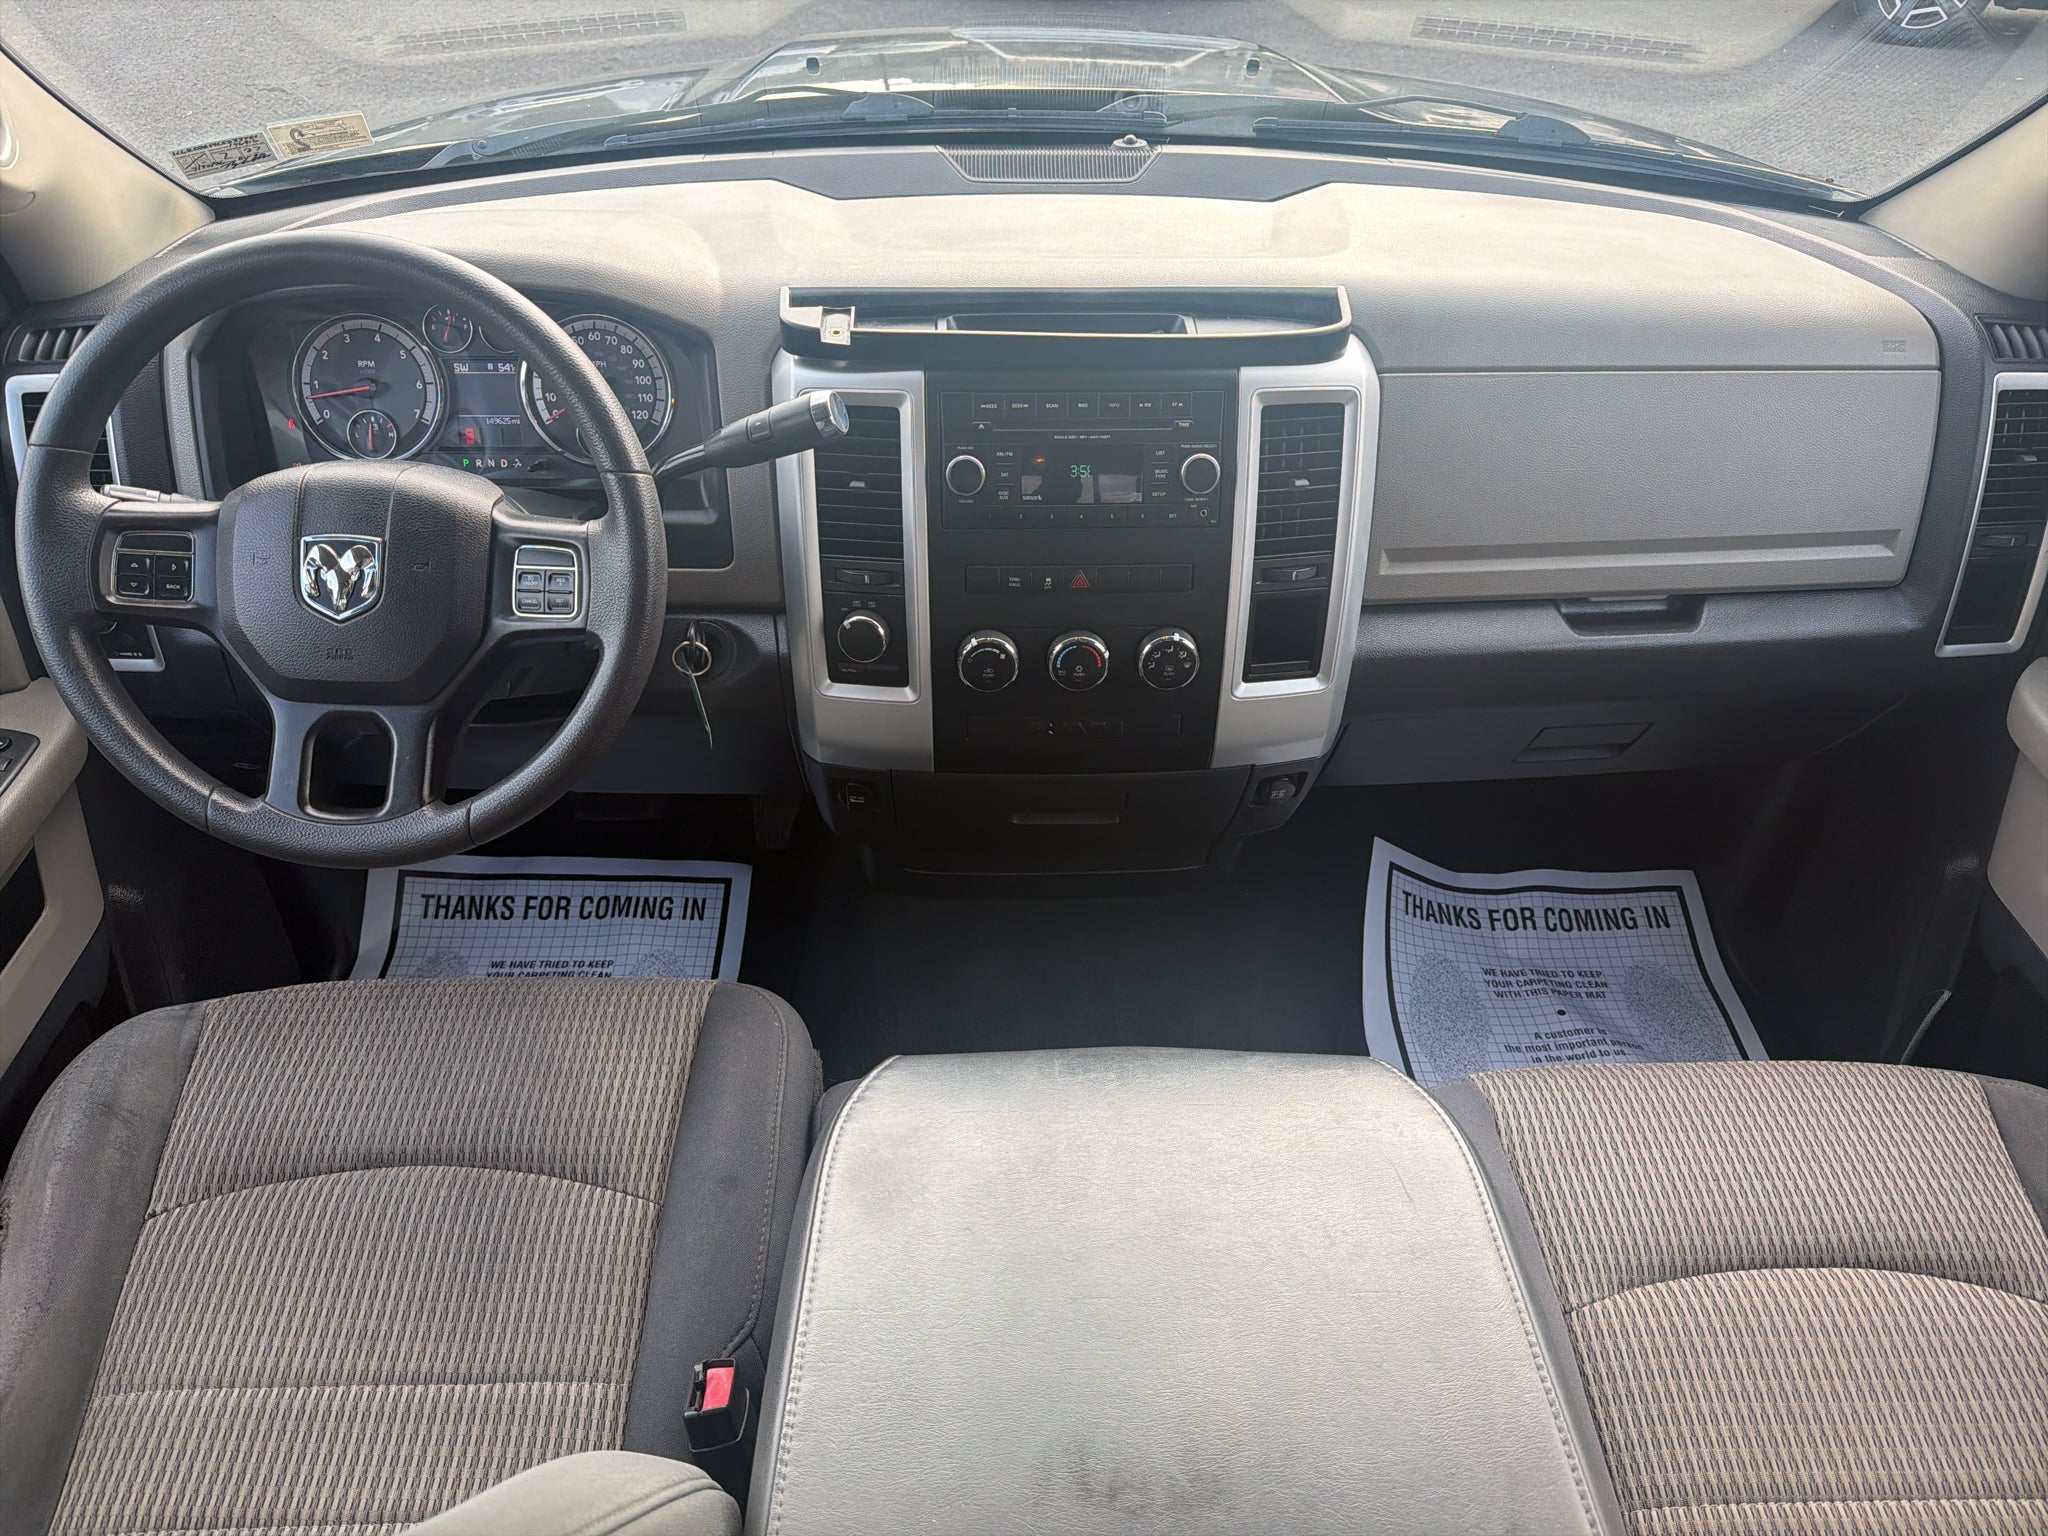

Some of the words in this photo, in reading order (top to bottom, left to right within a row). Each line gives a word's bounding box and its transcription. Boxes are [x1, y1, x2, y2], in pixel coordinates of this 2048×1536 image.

[343, 334, 351, 343] 3
[374, 334, 381, 343] 4
[588, 331, 601, 341] 60
[605, 336, 618, 346] 70
[620, 345, 633, 354] 80
[321, 350, 329, 360] 2
[400, 350, 407, 360] 5
[357, 360, 376, 368] RPM
[453, 363, 469, 372] SW
[632, 359, 645, 368] 90
[313, 380, 319, 389] 1
[635, 376, 652, 385] 100
[416, 382, 423, 390] 6
[545, 393, 557, 402] 10
[637, 393, 654, 402] 110
[323, 409, 331, 419] 0
[413, 409, 421, 419] 7
[631, 410, 649, 420] 120
[463, 459, 470, 468] P
[476, 459, 482, 468] R
[488, 459, 495, 468] N
[500, 459, 508, 468] D
[420, 893, 515, 921] THANKS
[522, 895, 572, 921] FOR
[578, 895, 675, 921] COMING
[681, 897, 707, 921] IN
[1402, 890, 1482, 931] THANKS
[1488, 906, 1538, 932] FOR
[1543, 906, 1639, 932] COMING
[1643, 905, 1671, 929] IN
[490, 960, 507, 969] WE
[509, 960, 536, 969] HAVE
[538, 960, 569, 969] TRIED
[573, 960, 586, 968] TO
[587, 960, 614, 968] KEEP
[1481, 967, 1498, 977] WE
[1500, 968, 1527, 978] HAVE
[1528, 968, 1559, 978] TRIED
[1560, 970, 1575, 978] TO
[1576, 970, 1602, 978] KEEP
[1484, 979, 1514, 988] YOUR
[1516, 978, 1573, 989] CARPETING
[1575, 980, 1608, 989] CLEAN
[1493, 990, 1522, 999] WITH
[1523, 987, 1549, 997] THIS
[1550, 988, 1583, 999] PAPER
[1584, 991, 1607, 999] MAT
[1534, 1032, 1543, 1040] A
[1545, 1028, 1595, 1040] customer
[1503, 1044, 1522, 1053] the
[1525, 1043, 1552, 1053] most
[1554, 1038, 1608, 1051] important
[1530, 1055, 1543, 1064] in
[1544, 1053, 1561, 1063] the
[1565, 1050, 1597, 1061] world
[1598, 1048, 1611, 1057] to
